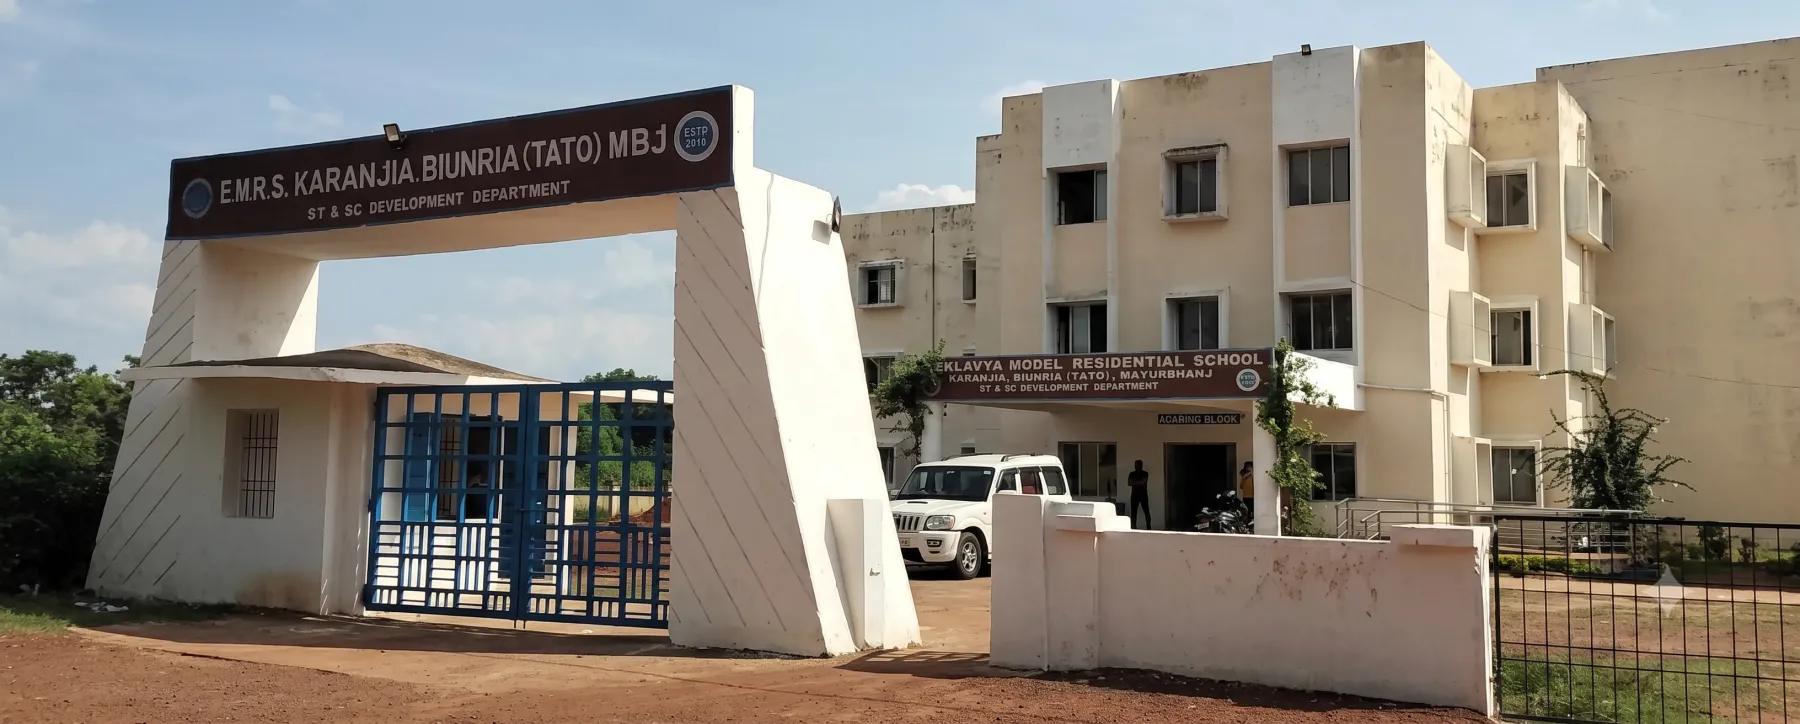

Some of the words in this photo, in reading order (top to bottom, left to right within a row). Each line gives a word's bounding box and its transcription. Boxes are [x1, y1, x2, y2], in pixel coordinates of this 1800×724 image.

[685, 138, 707, 148] 2010
[220, 173, 289, 204] E.M.R.S.
[522, 131, 601, 171] (TATO)
[609, 124, 667, 159] MBJ
[307, 207, 326, 220] ST
[330, 205, 340, 218] &
[344, 203, 362, 217] SC
[369, 192, 464, 214] DEVELOPMENT
[472, 180, 571, 204] DEPARTMENT
[936, 360, 1003, 372] EKLAVYA
[1009, 359, 1063, 371] MODEL
[1072, 356, 1185, 369] RESIDENTIAL
[1193, 353, 1264, 367] SCHOOL
[949, 373, 1010, 383] KARANJIA,
[1013, 372, 1062, 382] BIUNRIA
[1120, 369, 1213, 380] MAYURBHANJ
[979, 384, 991, 393] ST
[994, 384, 1001, 392] &
[1004, 384, 1017, 393] SC
[1020, 383, 1089, 392] DEVELOPMENT
[1093, 382, 1159, 391] DEPARTMENT
